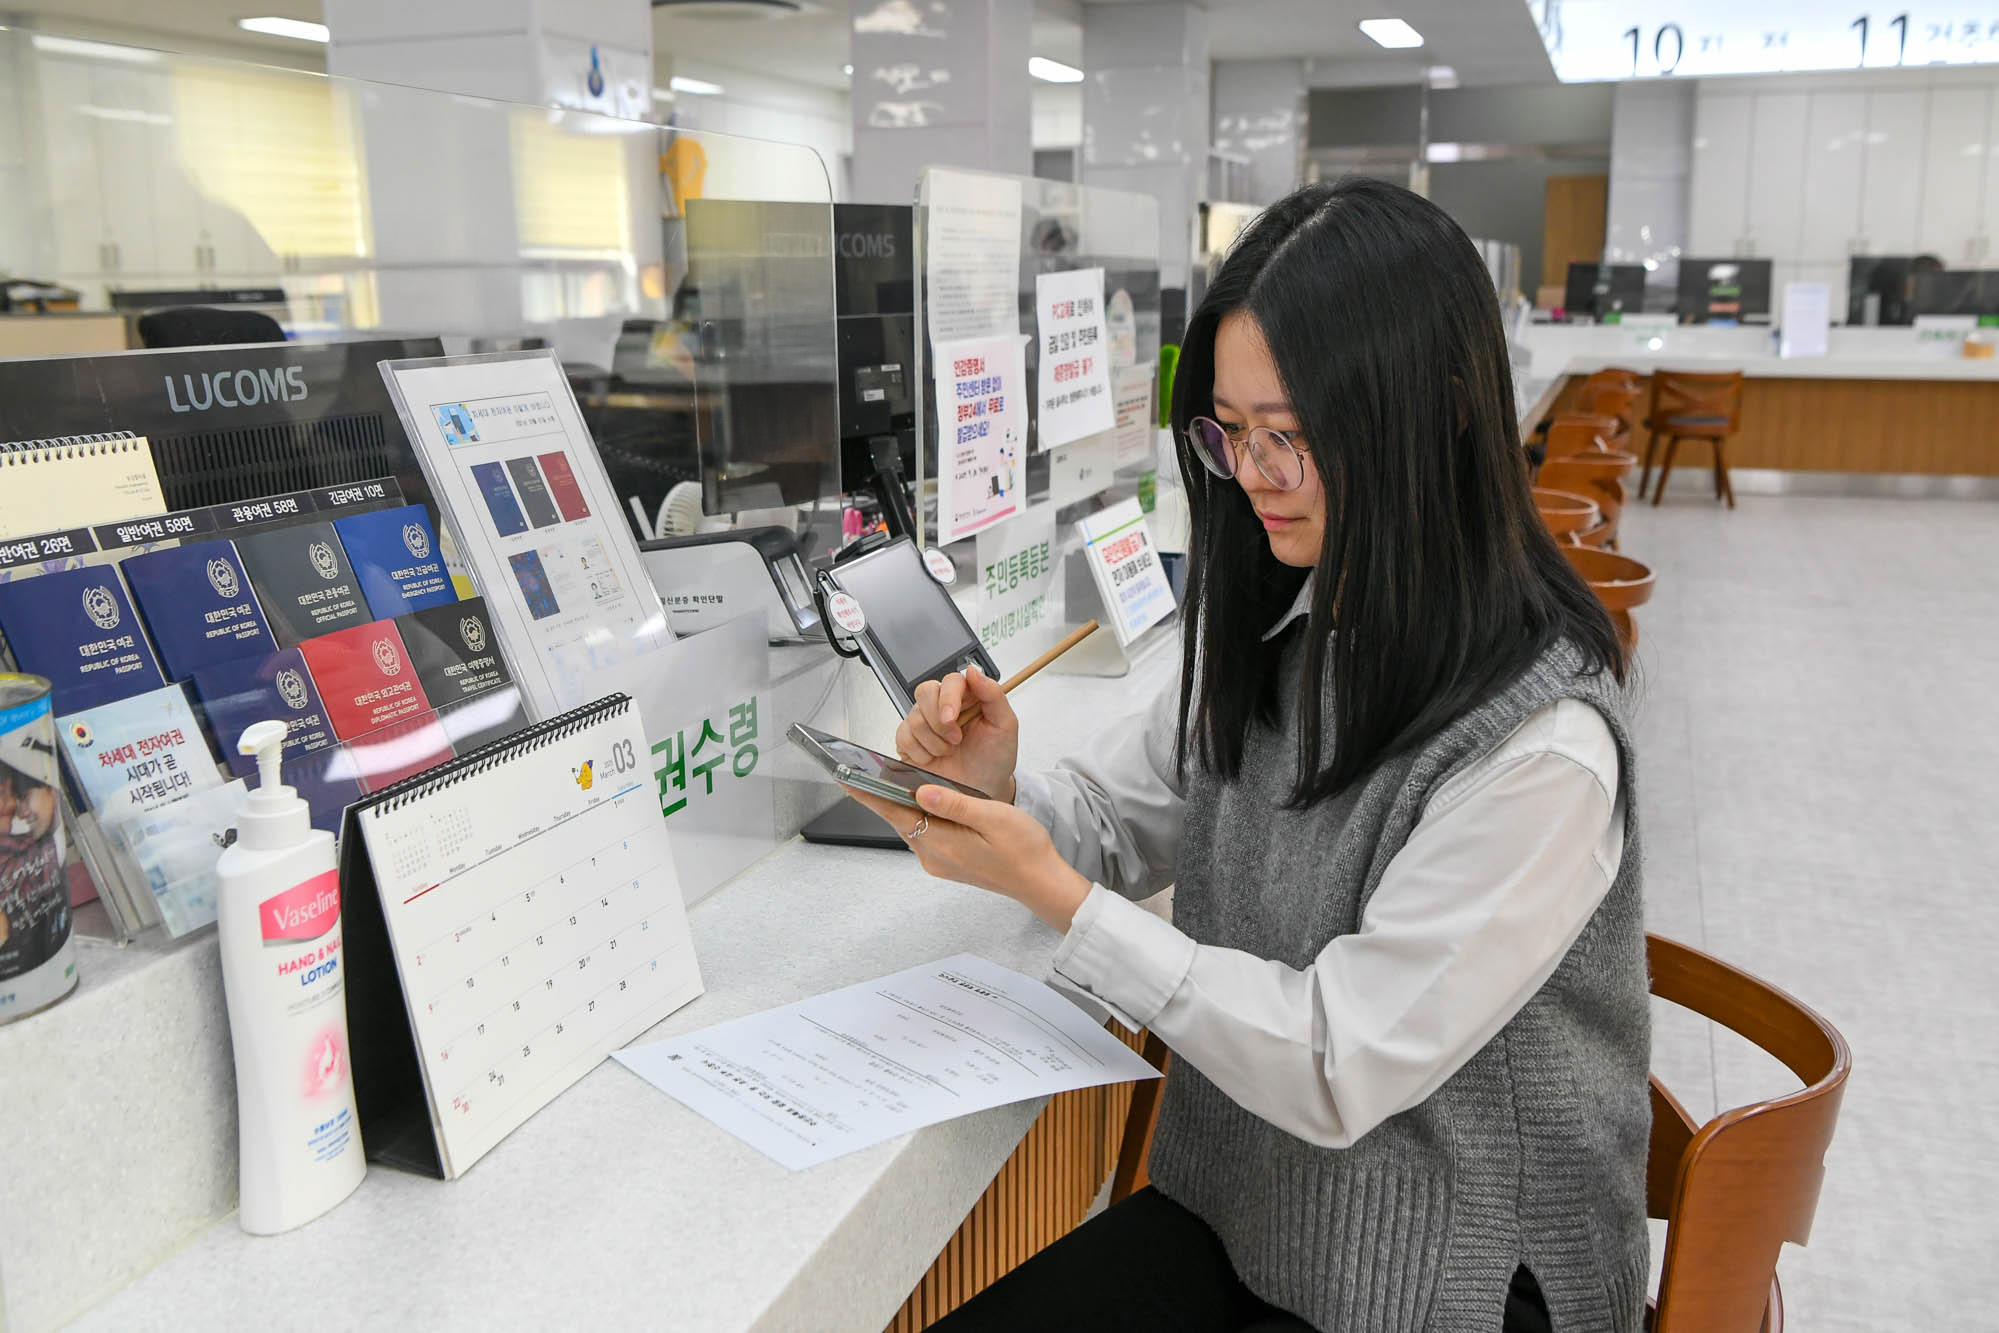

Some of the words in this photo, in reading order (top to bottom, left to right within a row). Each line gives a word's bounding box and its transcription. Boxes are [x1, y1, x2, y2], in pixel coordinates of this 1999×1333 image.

[1624, 22, 1683, 76] 10
[1851, 14, 1908, 67] 11
[954, 357, 985, 378] 인감증명서
[165, 366, 309, 413] LUCOMS
[328, 487, 363, 505] 긴급여권
[364, 484, 385, 498] 10면
[231, 502, 274, 523] 관용여권
[274, 498, 300, 515] 58면
[116, 521, 165, 543] 일반여권
[165, 516, 195, 534] 58면
[0, 543, 40, 564] 반여권
[40, 535, 73, 555] 26면
[391, 567, 416, 580] 대한민국
[986, 539, 1049, 600] 주민등록등본
[297, 591, 325, 605] 대한민국
[692, 595, 723, 604] 확인단말
[205, 607, 237, 623] 대한민국
[237, 603, 252, 616] 여권
[79, 639, 117, 657] 대한민국
[117, 635, 134, 649] 여권
[80, 659, 110, 673] REPUBLIC
[354, 690, 381, 706] 대한민국
[98, 743, 136, 768] 차세대
[137, 728, 186, 757] 전자여권
[281, 736, 301, 749] PUBLIC
[126, 757, 163, 783] 시대가
[164, 753, 177, 771] 곧
[613, 739, 636, 774] 03
[651, 696, 759, 817] 권수령
[130, 771, 192, 805] 시작됩니다!
[525, 892, 531, 903] 5
[536, 935, 543, 946] 12
[569, 916, 577, 926] 13
[601, 898, 608, 908] 14
[278, 952, 316, 976] HAND
[579, 958, 586, 969] 20
[610, 940, 617, 949] 21
[301, 957, 337, 986] LOTION
